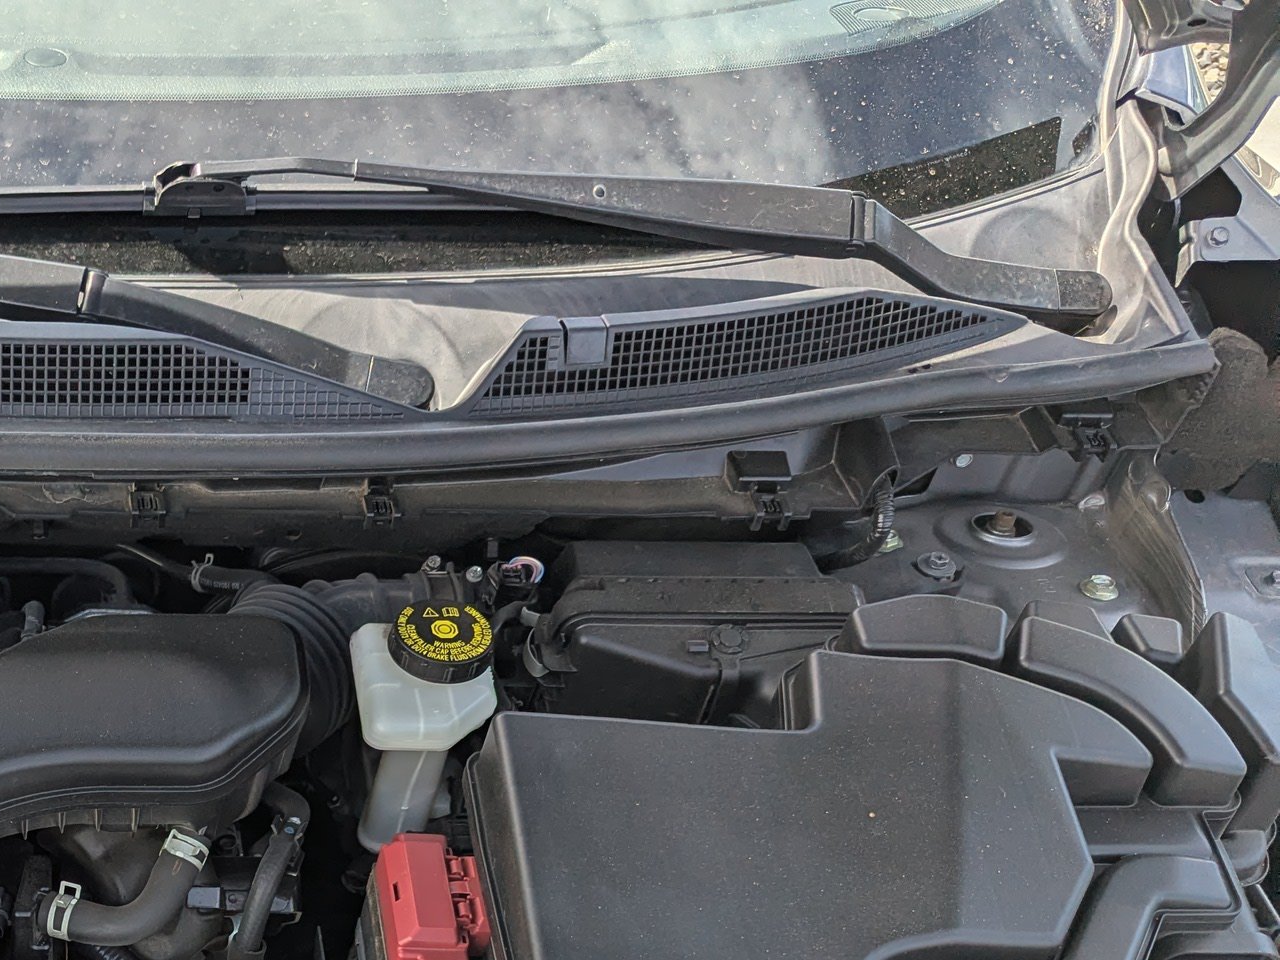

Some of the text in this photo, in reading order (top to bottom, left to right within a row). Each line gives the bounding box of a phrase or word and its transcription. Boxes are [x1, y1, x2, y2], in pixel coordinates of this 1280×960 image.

[415, 638, 435, 651] FILLER
[450, 644, 475, 655] BEFORE
[433, 640, 465, 648] WARNING
[427, 652, 449, 661] BRAKE
[450, 653, 468, 661] FLUID
[467, 646, 484, 658] FROM
